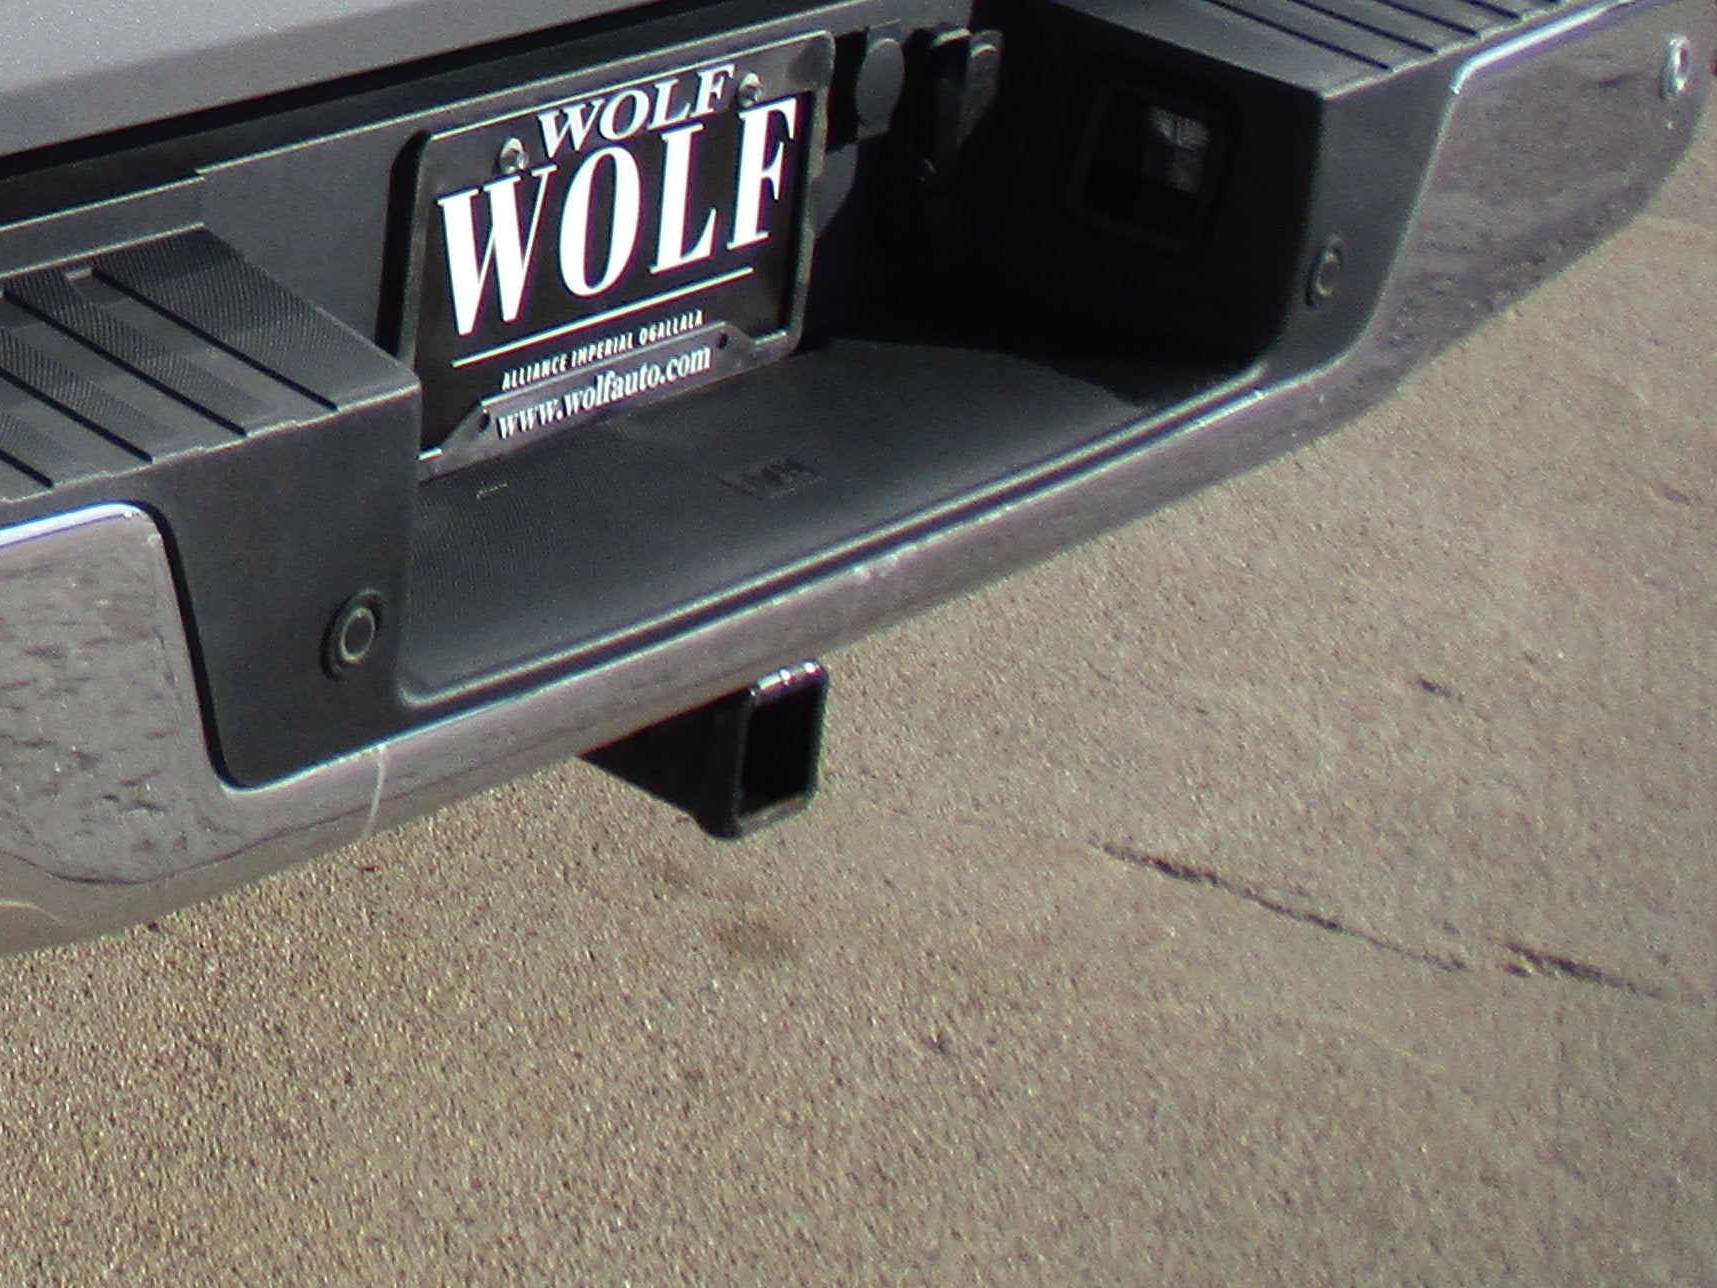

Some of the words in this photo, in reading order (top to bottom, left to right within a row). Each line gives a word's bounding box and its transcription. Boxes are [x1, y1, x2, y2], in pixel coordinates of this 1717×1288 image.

[537, 64, 735, 159] WOLF
[437, 98, 798, 336] WOLF
[497, 344, 713, 439] www.wolfauto.com
[501, 352, 567, 391] ALLIANCE
[571, 331, 633, 368] IMPERIAL
[638, 309, 704, 346] OGALLALA
